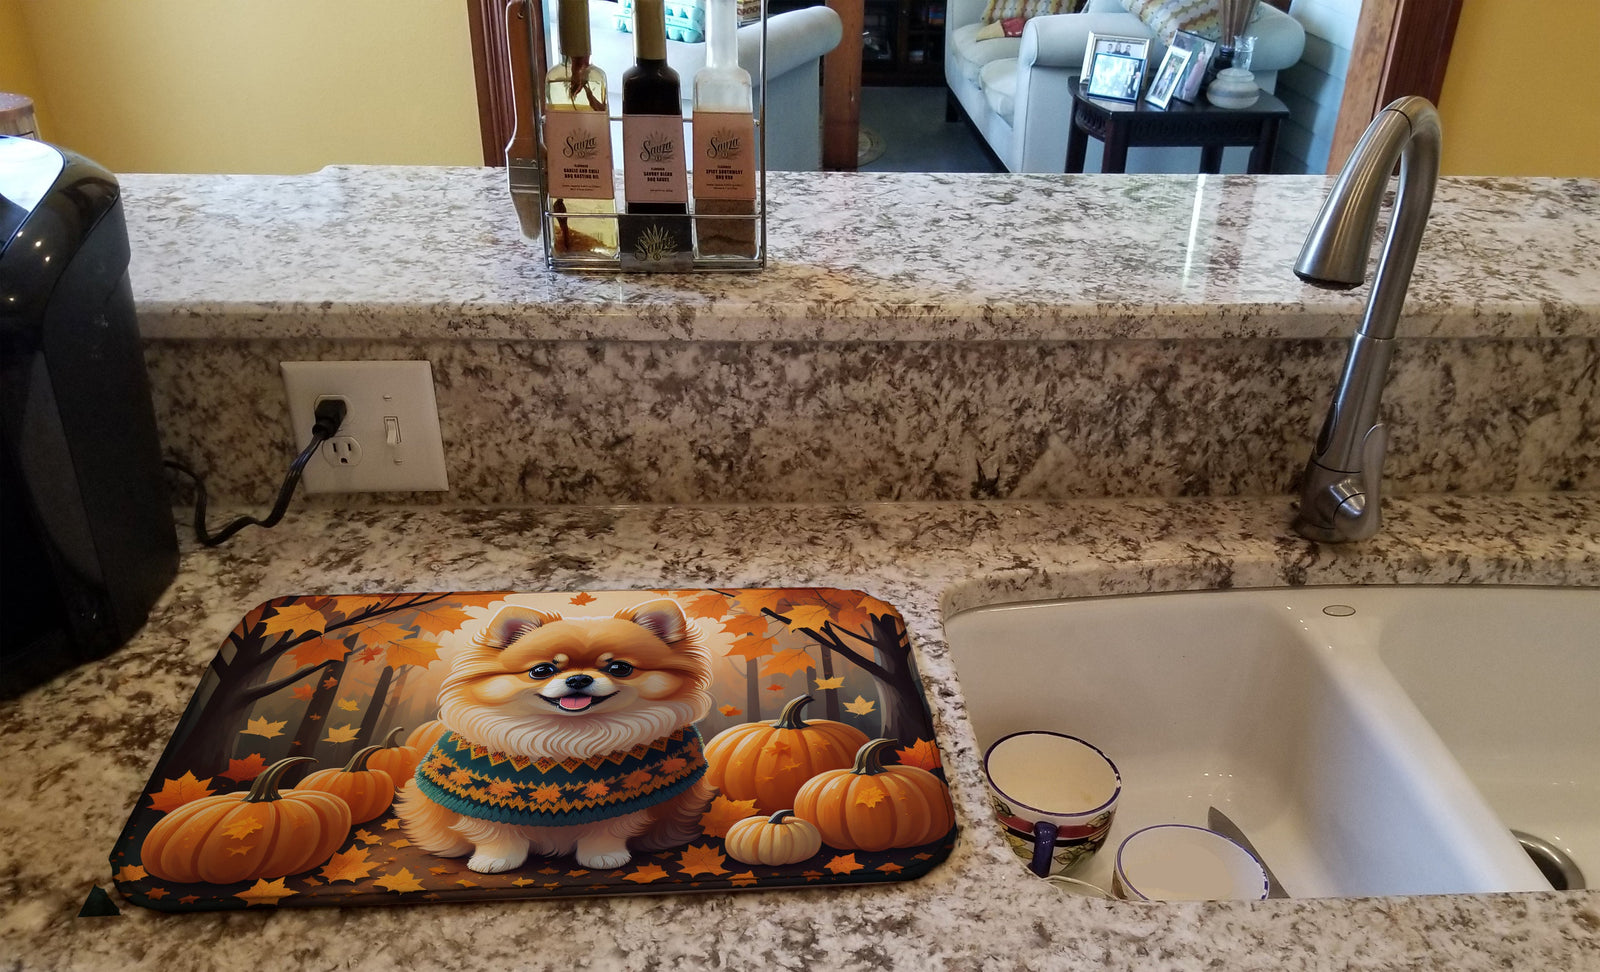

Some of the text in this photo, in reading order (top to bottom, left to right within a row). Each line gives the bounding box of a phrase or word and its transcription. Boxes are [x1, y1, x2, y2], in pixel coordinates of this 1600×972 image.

[562, 135, 598, 158] Sauza
[639, 140, 673, 162] Sauza
[706, 136, 740, 159] Sauza
